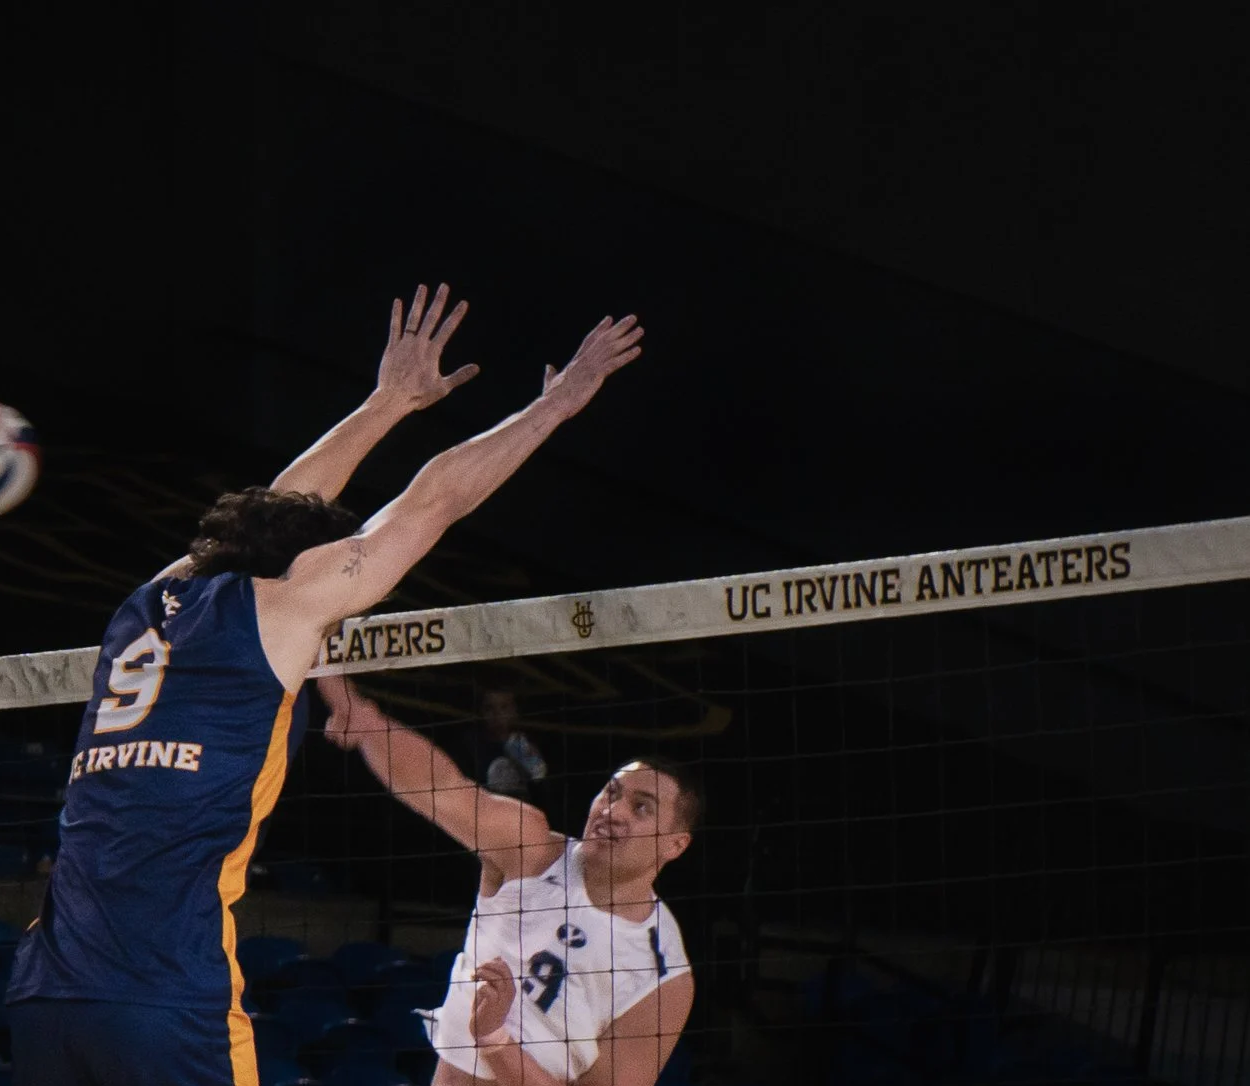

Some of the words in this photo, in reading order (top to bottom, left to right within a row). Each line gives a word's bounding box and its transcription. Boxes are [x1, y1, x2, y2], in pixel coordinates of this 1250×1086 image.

[726, 584, 771, 621] UC
[783, 569, 901, 616] IRVINE
[915, 542, 1131, 601] ANTEATERS
[326, 619, 446, 665] EATERS
[93, 627, 170, 734] 9
[85, 740, 203, 773] IRVINE
